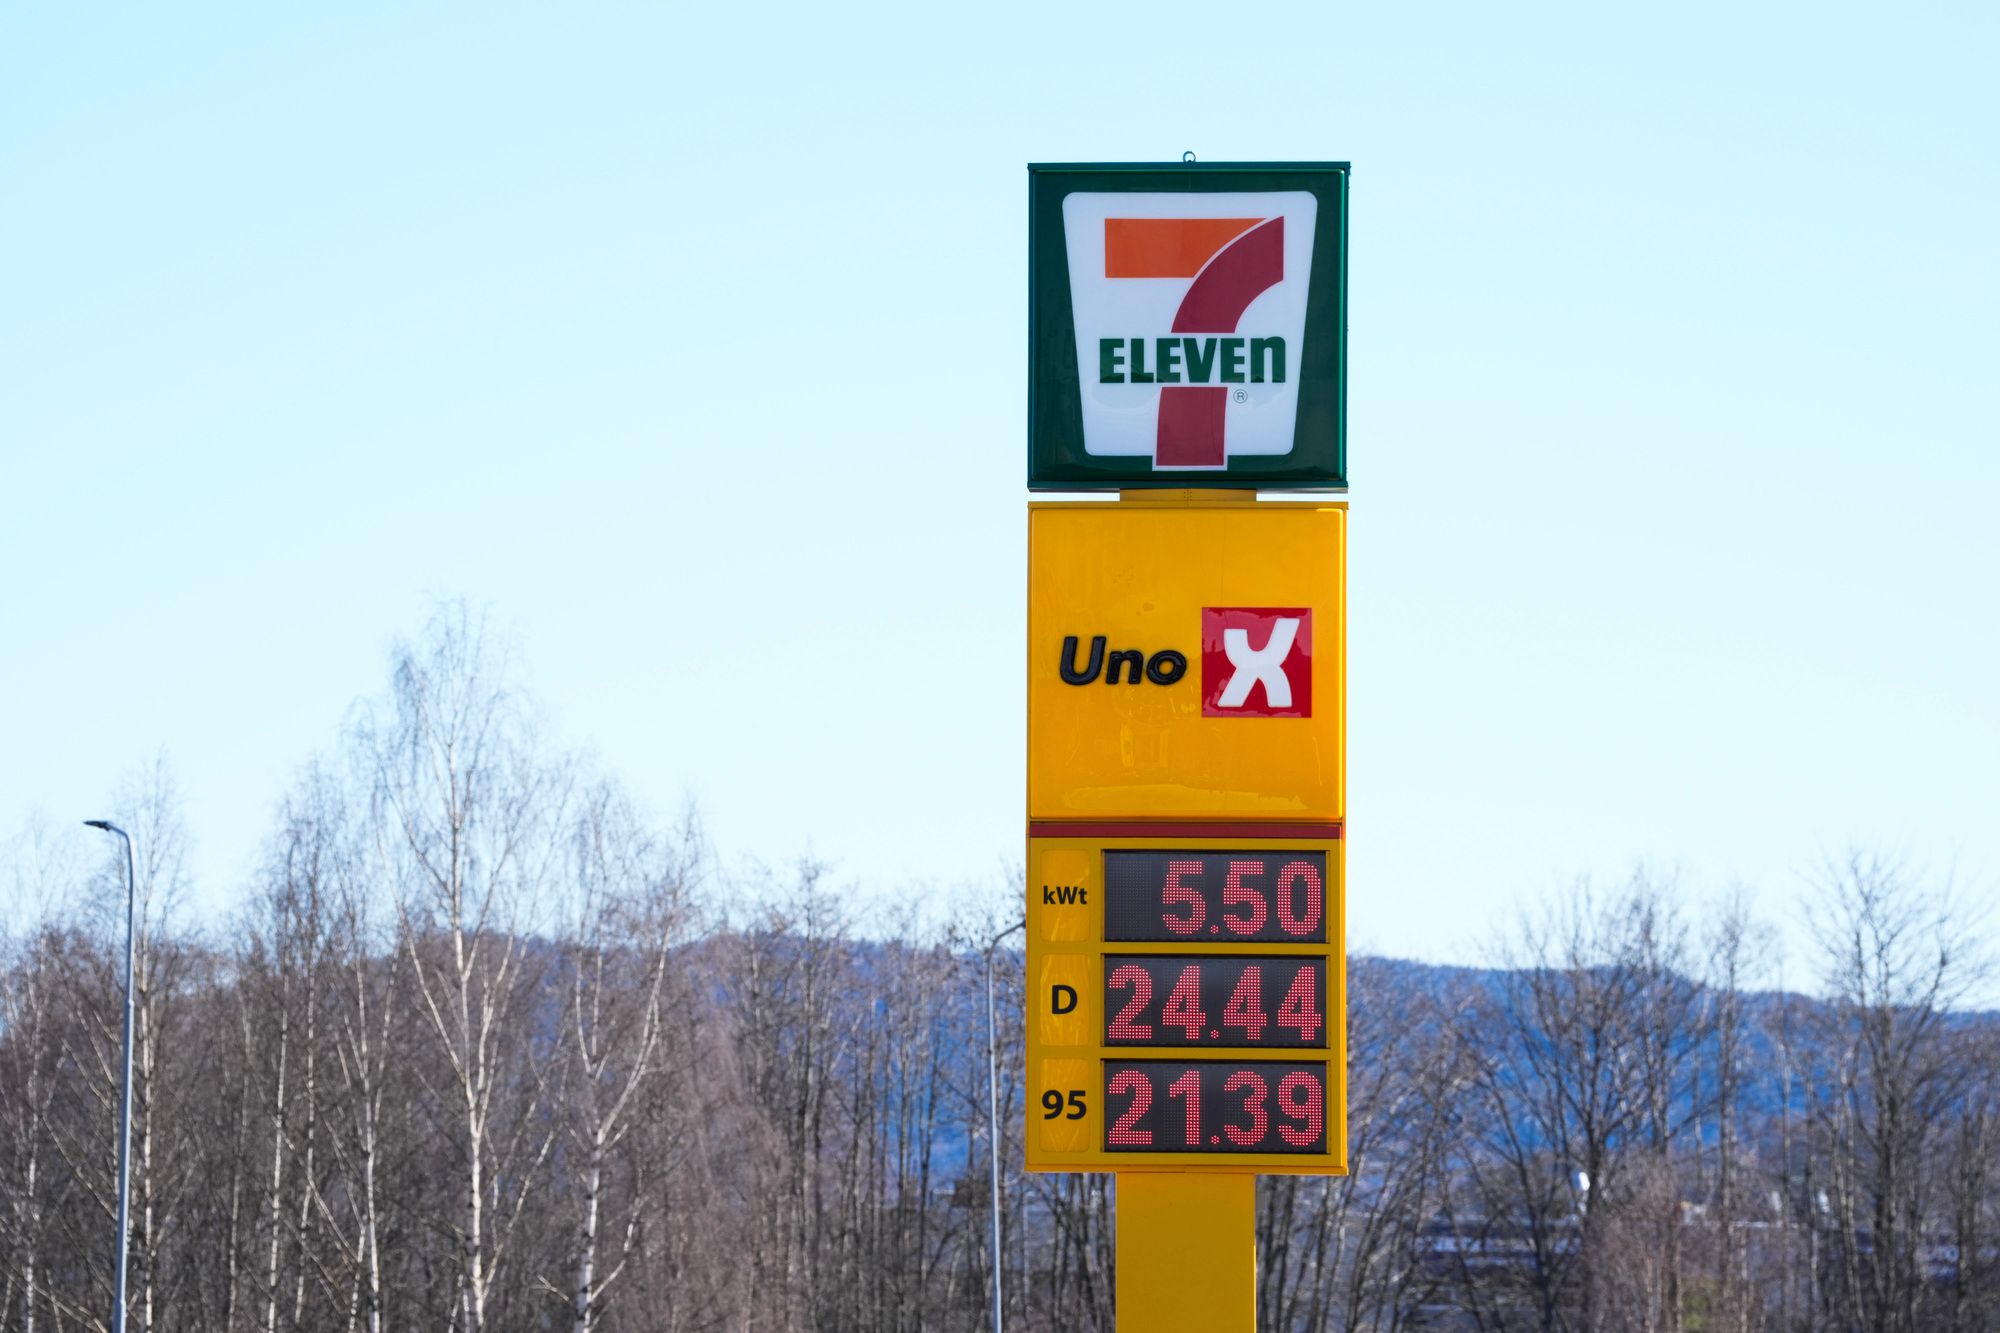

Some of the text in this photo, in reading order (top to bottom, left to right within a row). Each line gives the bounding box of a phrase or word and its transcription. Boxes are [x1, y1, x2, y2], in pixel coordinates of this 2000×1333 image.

[1105, 216, 1284, 467] 7
[1059, 617, 1300, 708] Uno X
[1042, 861, 1321, 935] kWt 5.50
[1051, 965, 1321, 1040] D 24.44
[1041, 1070, 1322, 1146] 95 21.39
